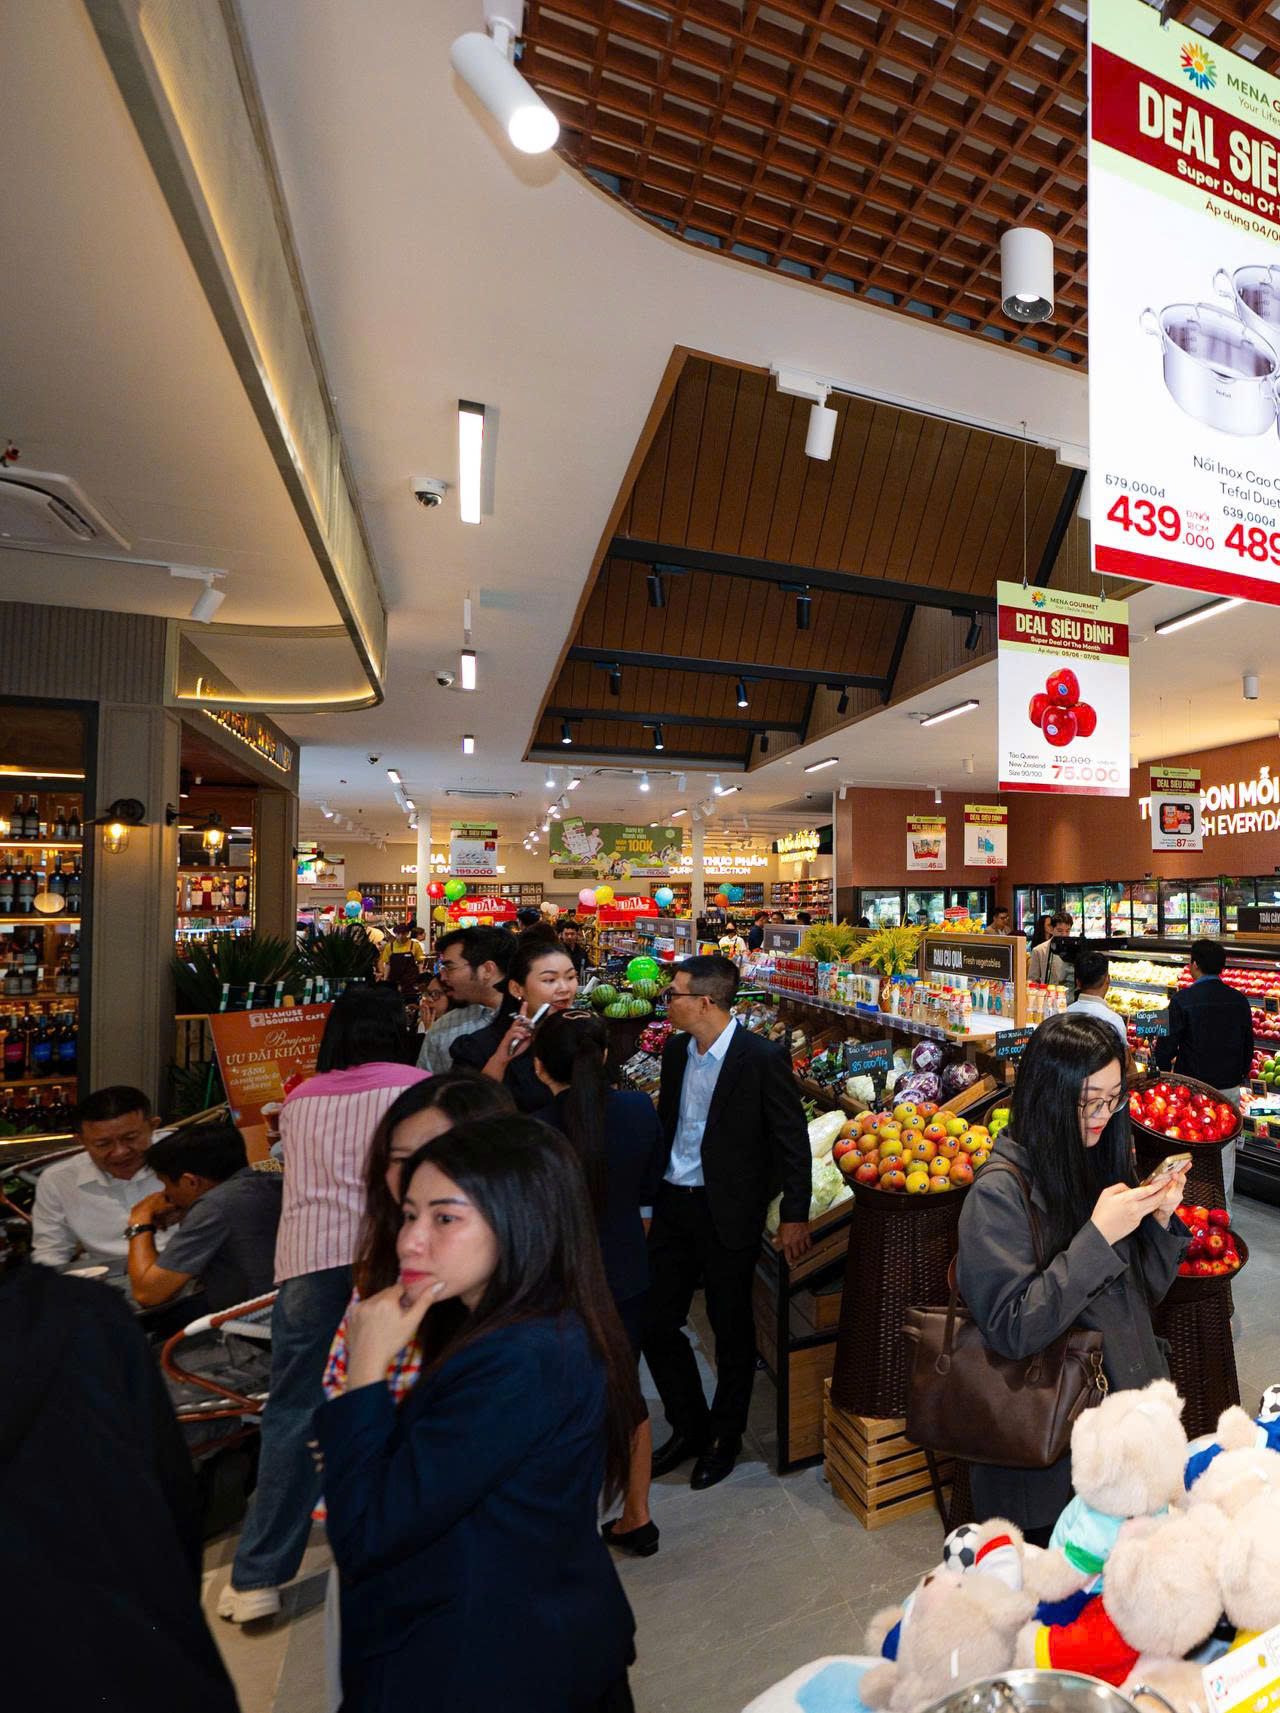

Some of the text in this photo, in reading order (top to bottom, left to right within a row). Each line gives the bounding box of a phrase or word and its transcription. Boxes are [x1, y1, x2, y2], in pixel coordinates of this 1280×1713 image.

[1227, 73, 1270, 108] MENA
[1238, 98, 1258, 119] Your
[1138, 81, 1220, 169] DEAL
[1177, 158, 1220, 192] Super
[1223, 180, 1255, 208] Deal
[1257, 197, 1275, 217] Of
[1205, 199, 1222, 220] Áp
[1223, 208, 1250, 232] dụng
[1193, 455, 1215, 472] Nồi
[1217, 462, 1243, 480] Inox
[1246, 471, 1271, 488] Cao
[1220, 481, 1250, 501] Tefal
[1106, 494, 1181, 542] 439
[1223, 505, 1276, 527] 639,000đ
[1182, 532, 1215, 550] .000
[1069, 601, 1098, 610] GOURMET
[1015, 612, 1114, 645] DEAL SIÊU ĐỈNH
[1031, 636, 1048, 645] Super
[1049, 638, 1062, 646] Deal
[1071, 641, 1081, 649] The
[1083, 643, 1100, 651] Month
[1052, 765, 1120, 782] 75.000
[1200, 783, 1235, 812] GON
[1239, 765, 1280, 807] MỖI
[628, 840, 654, 852] 100K
[1176, 838, 1187, 848] 87
[963, 955, 976, 965] Fresh
[976, 957, 1001, 969] vegetables
[265, 1009, 303, 1019] L'AMUSE
[265, 1015, 304, 1025] GOURMET
[226, 1053, 245, 1065] ƯU
[249, 1048, 271, 1063] ĐÃI
